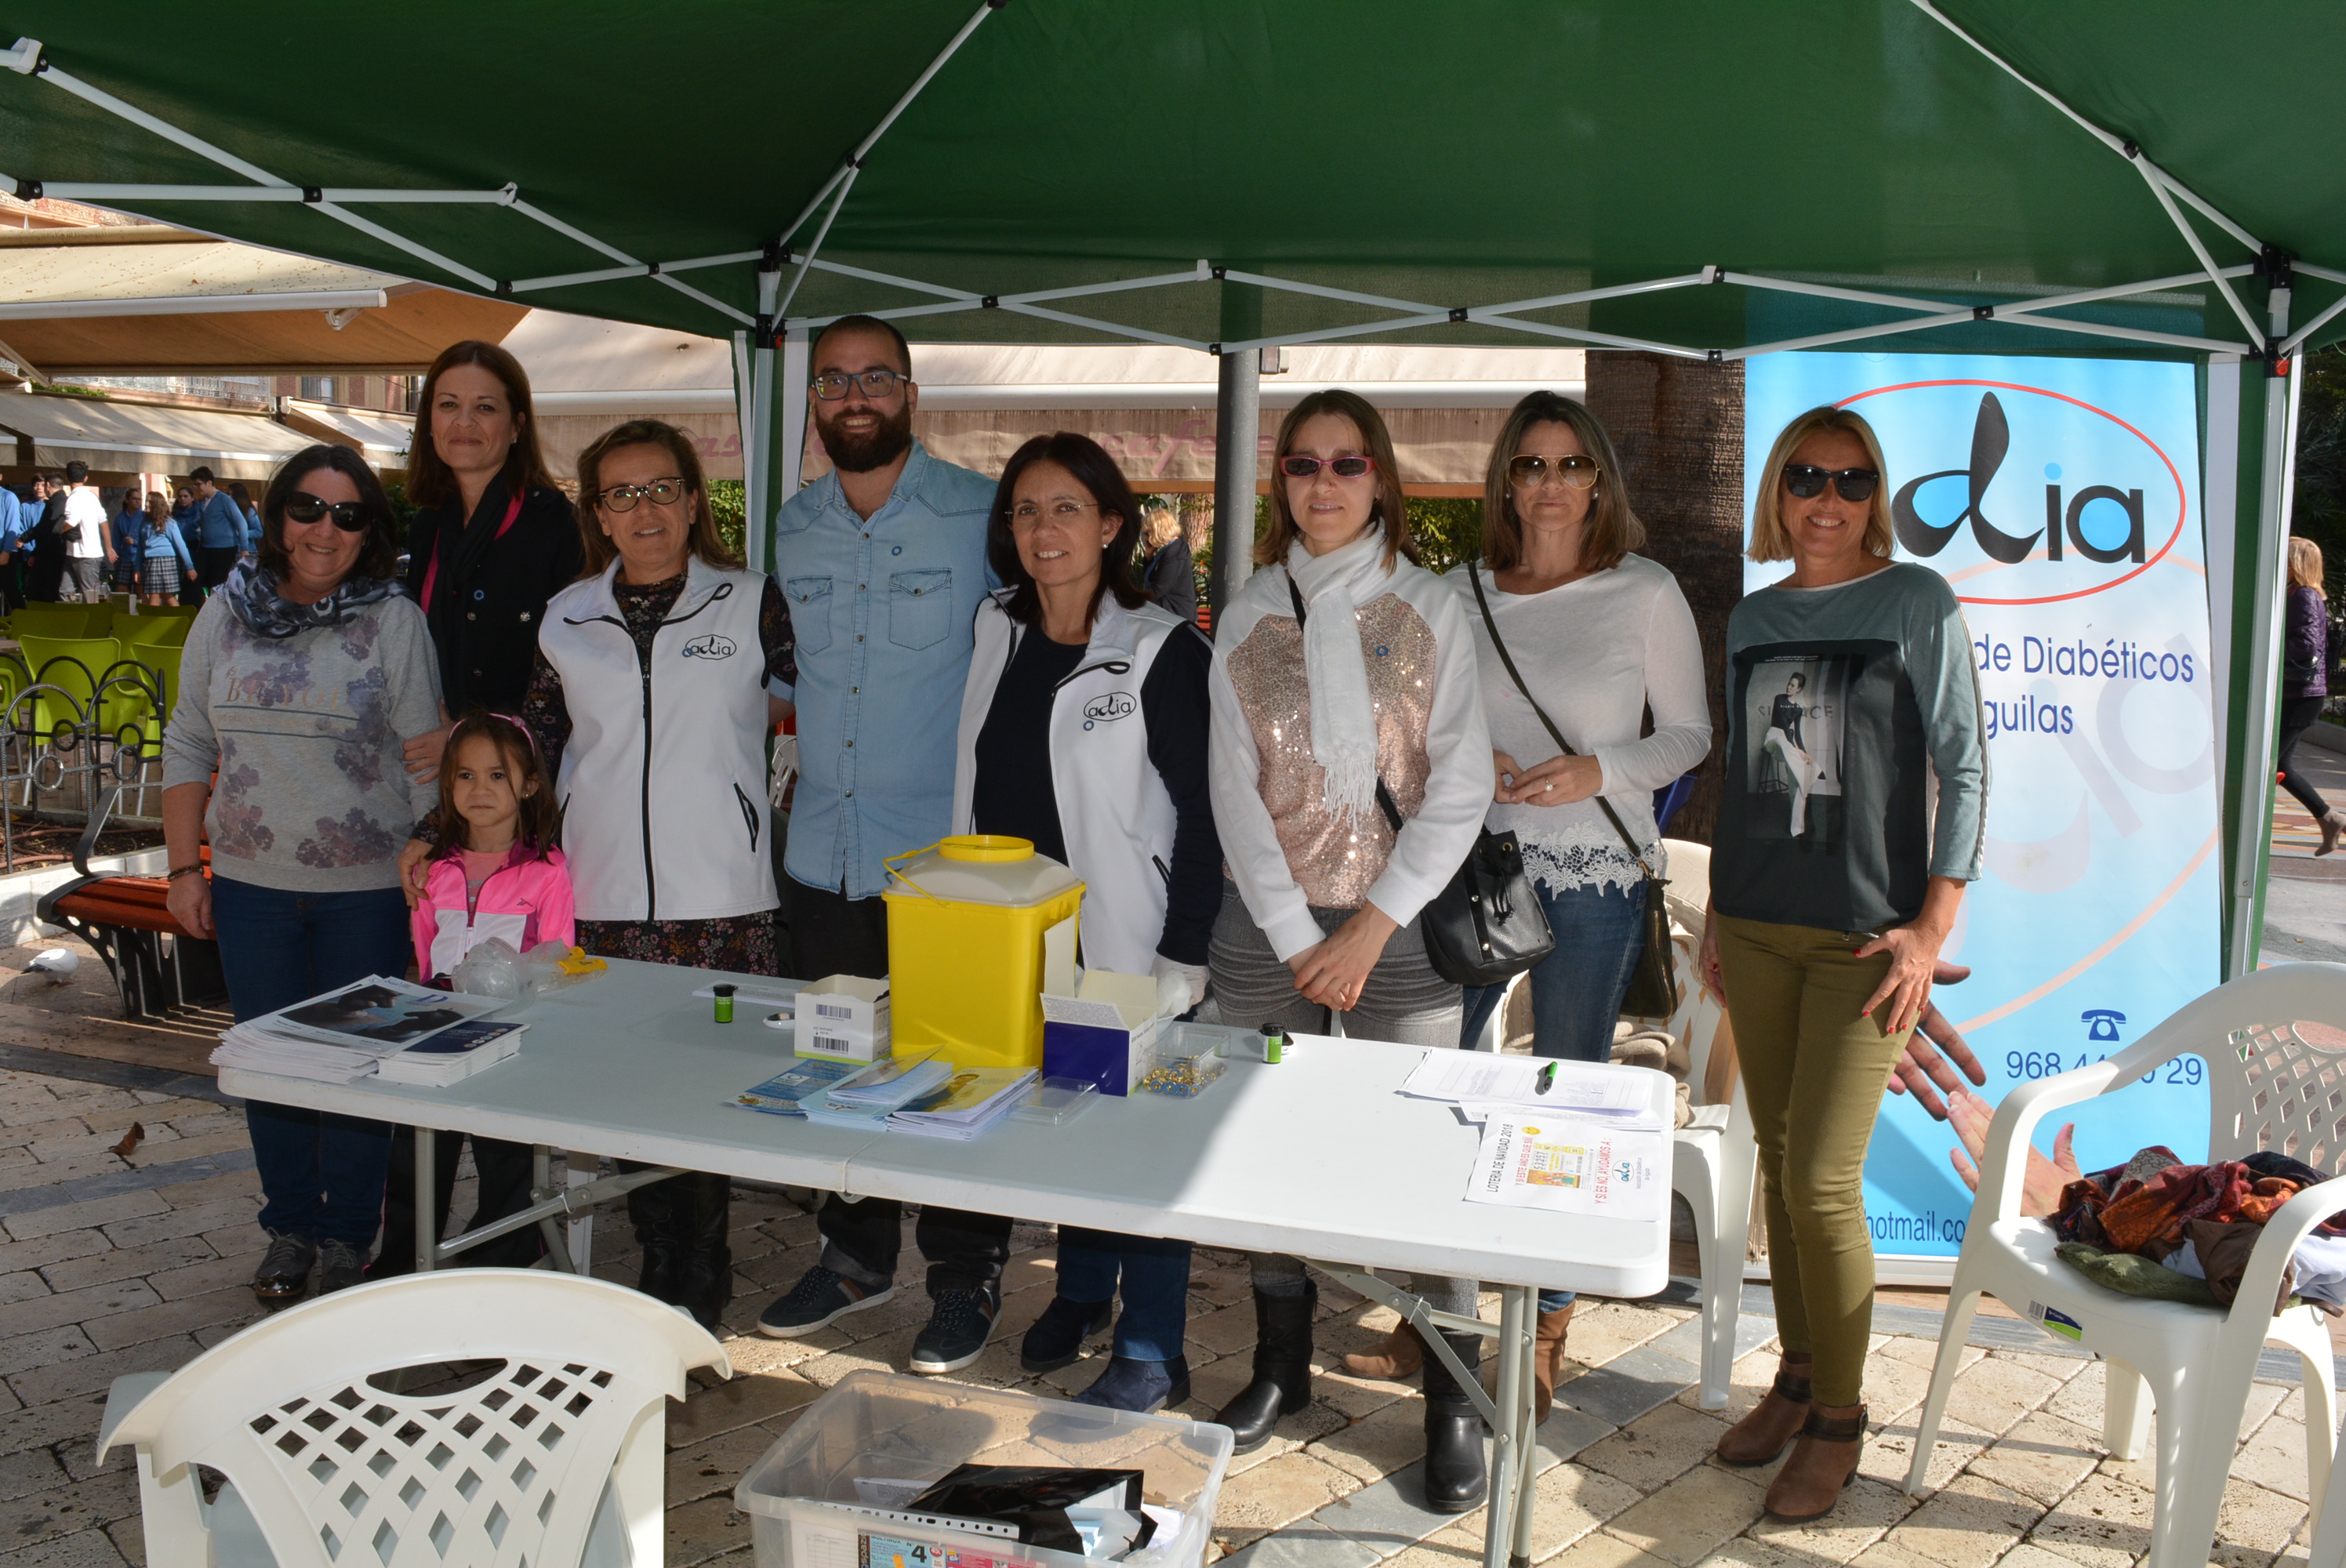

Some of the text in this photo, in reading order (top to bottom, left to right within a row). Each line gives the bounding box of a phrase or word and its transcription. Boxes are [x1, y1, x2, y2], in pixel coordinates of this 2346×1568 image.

[1890, 391, 2146, 564] dia
[690, 635, 732, 655] adia
[1974, 633, 2194, 683] de Diabéticos
[1088, 695, 1131, 717] adia
[1983, 695, 2074, 740] guilas
[2006, 1051, 2062, 1080] 968
[2166, 1058, 2203, 1086] 29
[1500, 1123, 1514, 1138] 2018
[1494, 1138, 1510, 1161] NAVIDAD
[1598, 1146, 1611, 1174] AYUDAMOS
[1493, 1160, 1505, 1169] DE
[1516, 1167, 1527, 1178] ESTE
[1522, 1144, 1531, 1153] QUE
[1533, 1151, 1546, 1171] 53257
[1596, 1185, 1607, 1193] ES
[911, 1544, 928, 1563] 4
